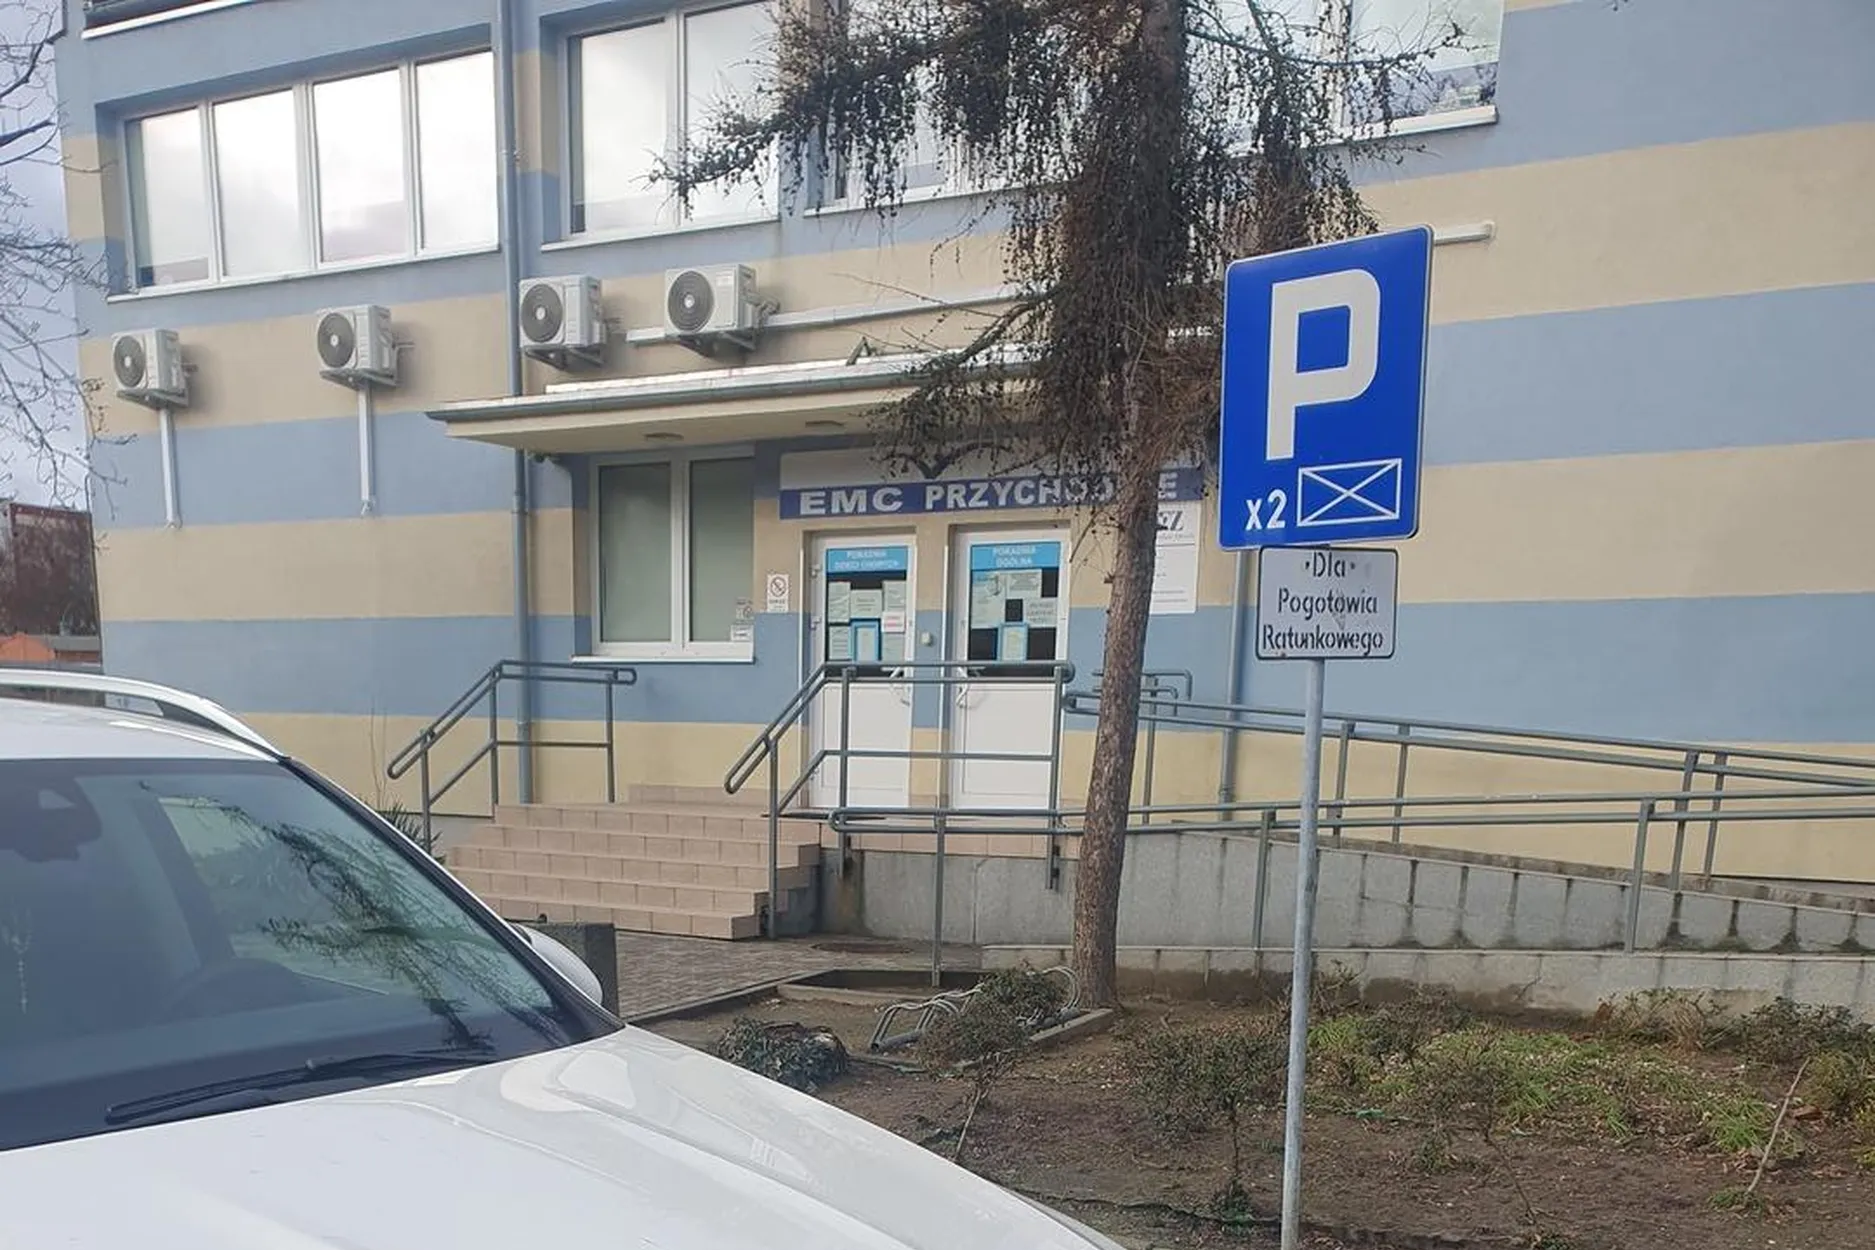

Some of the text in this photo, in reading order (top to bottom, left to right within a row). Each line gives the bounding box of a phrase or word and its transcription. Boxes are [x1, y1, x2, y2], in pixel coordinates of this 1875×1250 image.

[1266, 268, 1381, 461] P
[800, 471, 1178, 515] EMC PRZYCHODE
[1245, 488, 1287, 531] x2
[1312, 551, 1346, 578] Dla
[1278, 587, 1378, 621] Pogotowia
[1262, 624, 1384, 656] Ratunkowego
